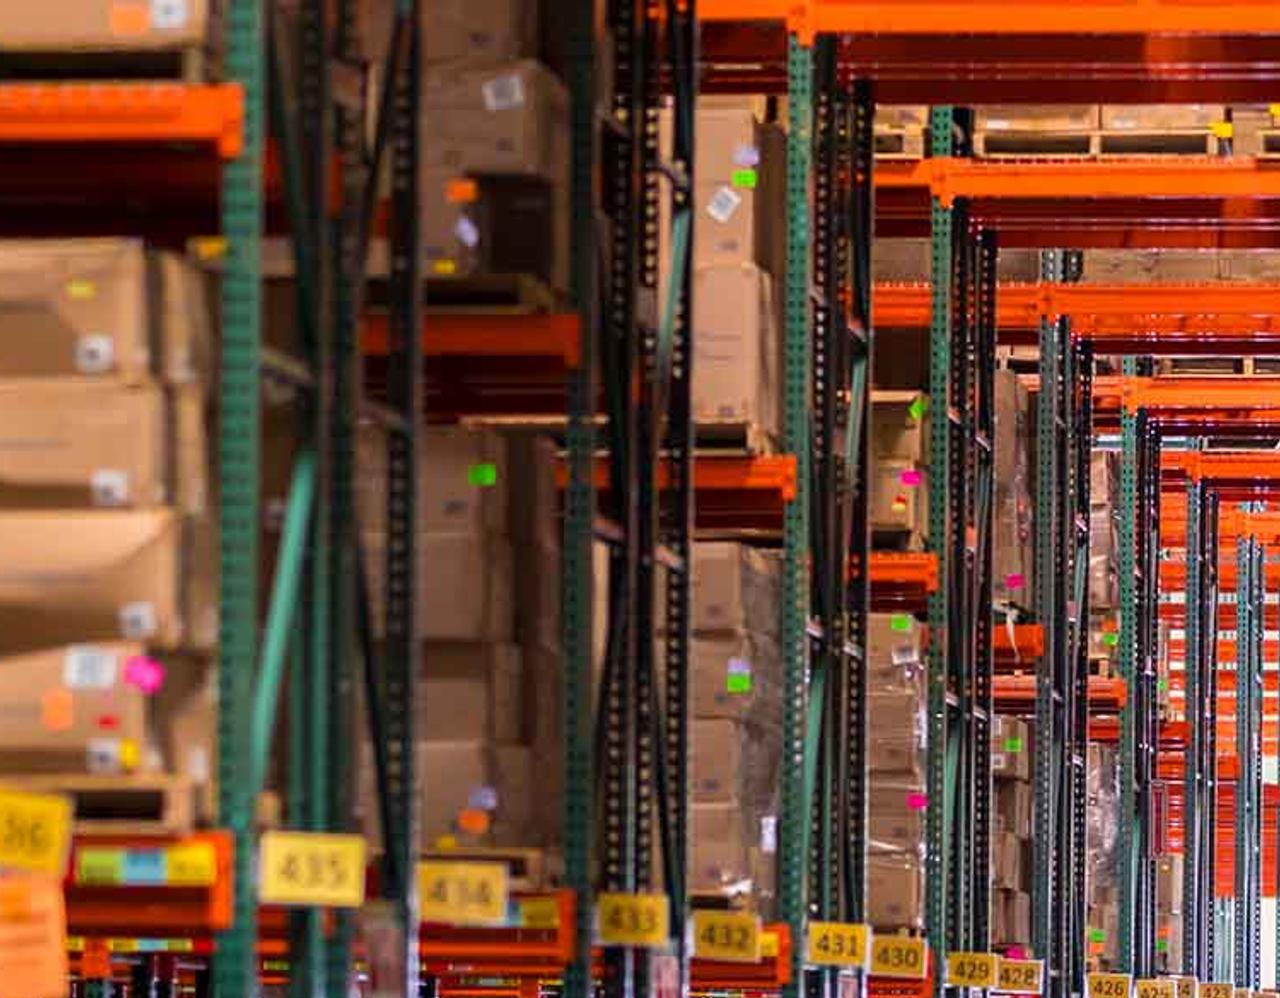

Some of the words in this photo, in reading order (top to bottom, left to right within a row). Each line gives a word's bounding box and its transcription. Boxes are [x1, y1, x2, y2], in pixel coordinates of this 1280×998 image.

[605, 905, 658, 931] 433
[700, 922, 749, 948] 432
[817, 932, 859, 957] 431
[877, 946, 919, 968] 430
[954, 960, 990, 981] 429
[1000, 966, 1036, 986] 428
[1093, 980, 1124, 997] 426
[1204, 986, 1229, 998] 423
